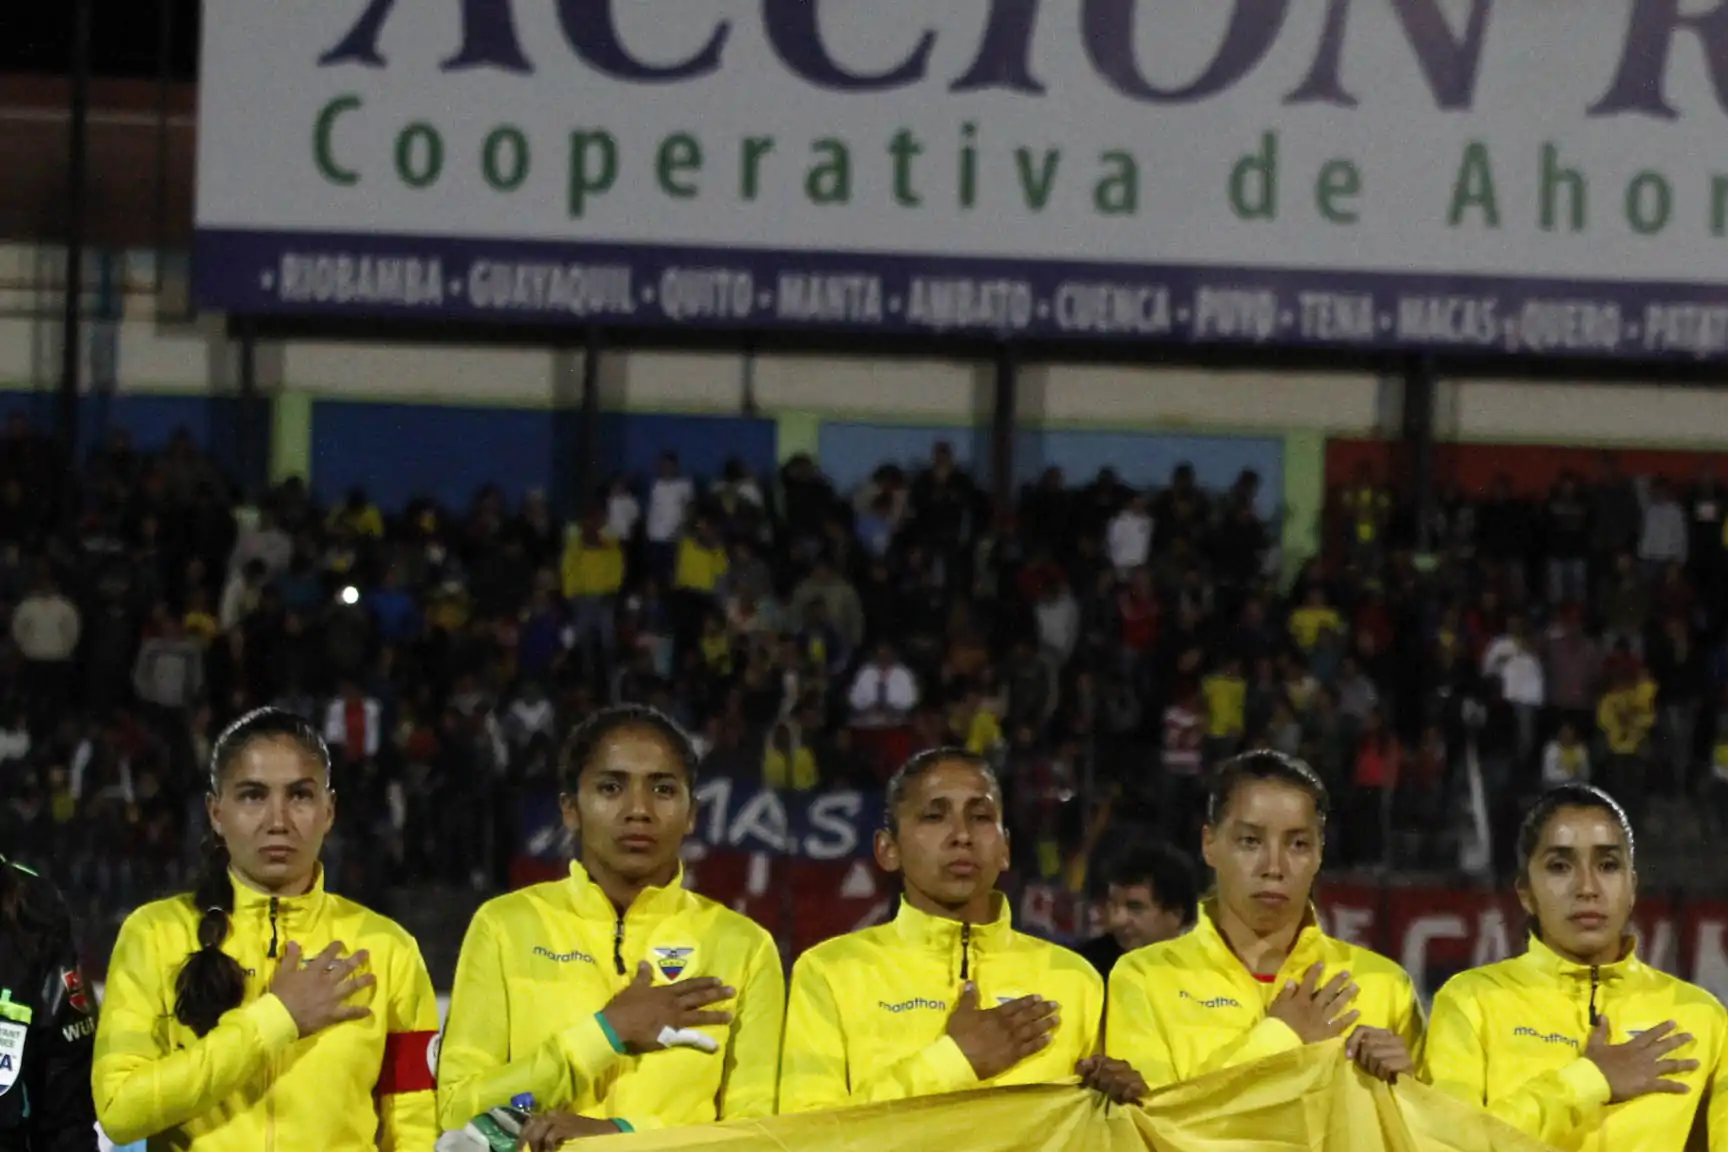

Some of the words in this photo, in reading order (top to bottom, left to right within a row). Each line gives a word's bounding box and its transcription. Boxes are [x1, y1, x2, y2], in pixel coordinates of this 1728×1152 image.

[313, 94, 1139, 216] Cooperativa
[1227, 130, 1361, 224] de
[279, 253, 442, 305] RIOBAMBA
[469, 260, 636, 315] GUAYAQUIL
[660, 268, 752, 320] QUITO
[778, 273, 882, 321] MANTA
[908, 277, 1031, 331] AMBATO
[1056, 284, 1171, 334] CUENCA
[1194, 287, 1278, 341] PUYO
[1301, 291, 1374, 340] TENA
[1398, 296, 1496, 346] MACAS
[1519, 301, 1620, 353] QUERO
